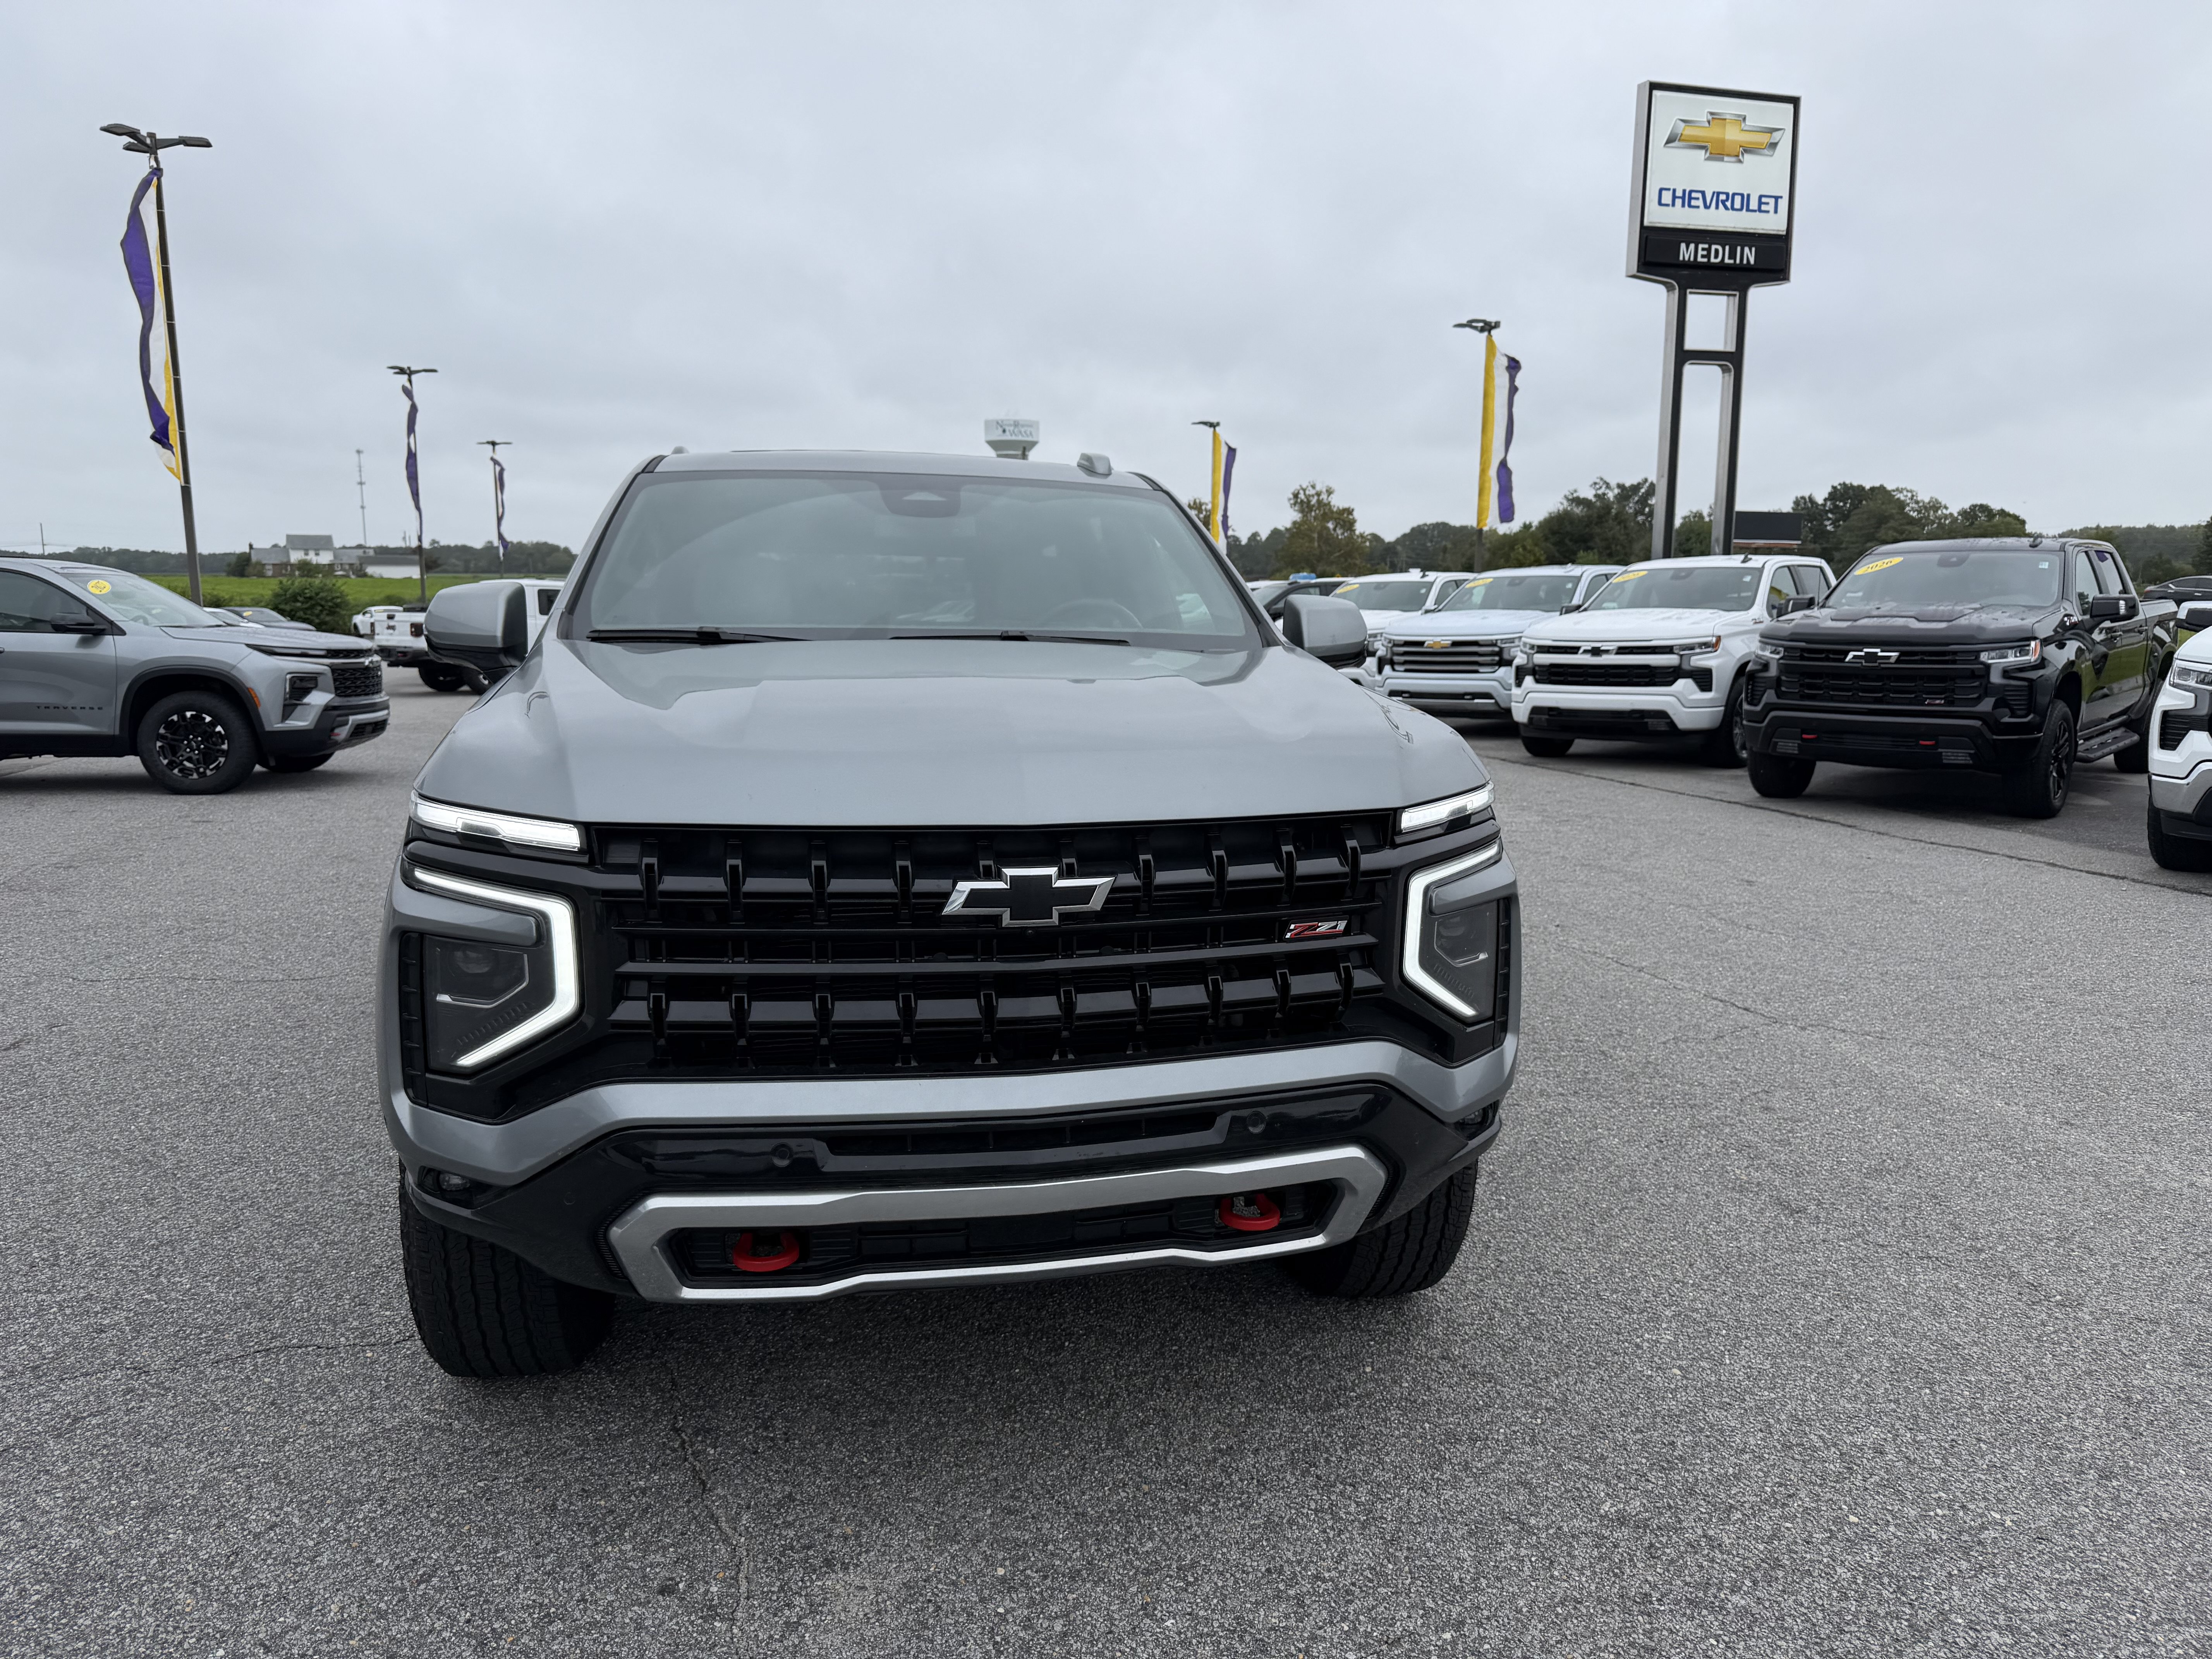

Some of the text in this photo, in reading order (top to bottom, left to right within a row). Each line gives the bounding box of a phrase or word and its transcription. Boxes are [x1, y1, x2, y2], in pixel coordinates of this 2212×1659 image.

[1657, 187, 1783, 214] CHEVROLET
[1679, 242, 1756, 265] MEDLIN
[1285, 920, 1348, 938] Z71
